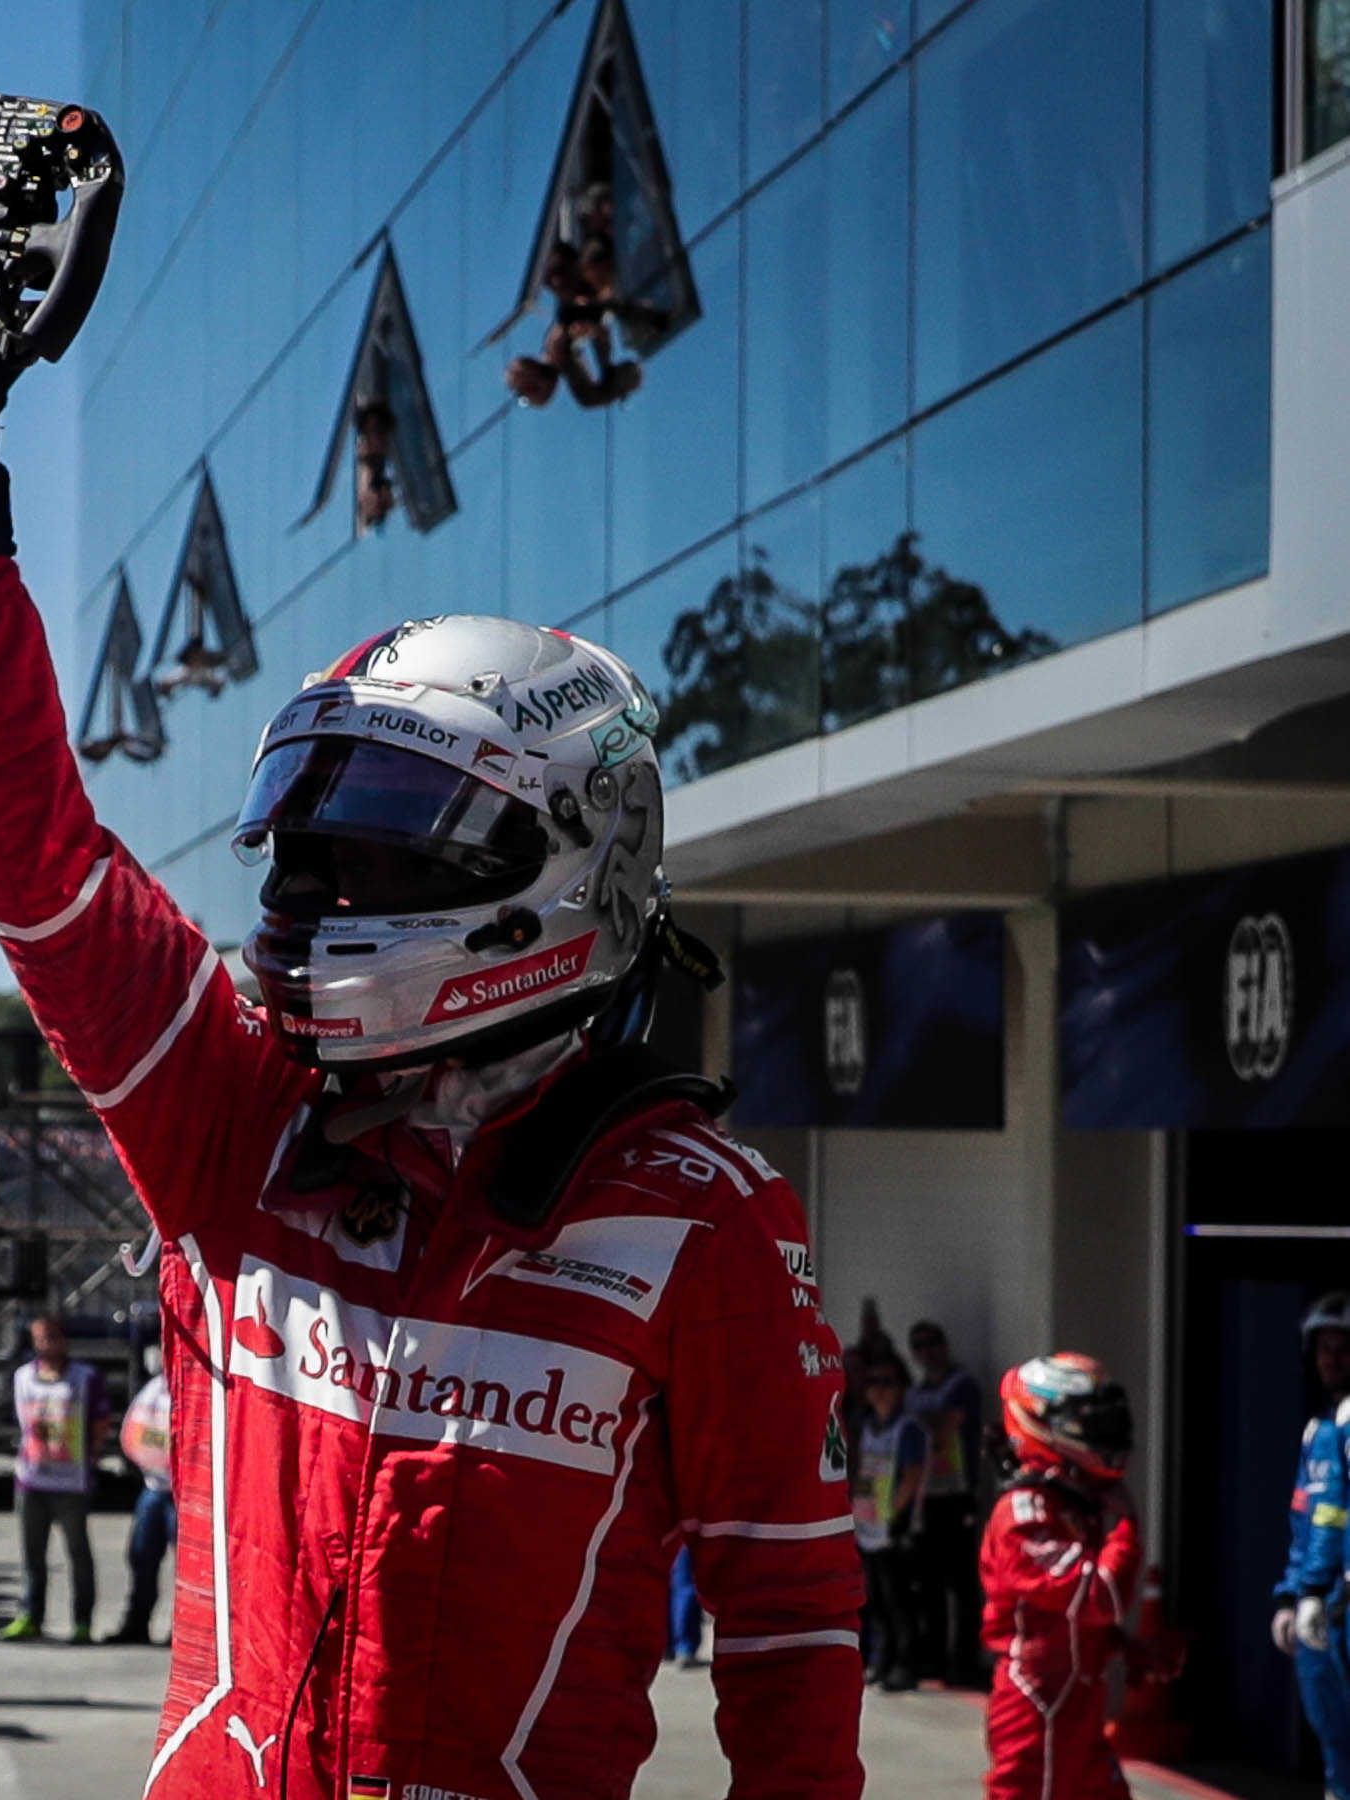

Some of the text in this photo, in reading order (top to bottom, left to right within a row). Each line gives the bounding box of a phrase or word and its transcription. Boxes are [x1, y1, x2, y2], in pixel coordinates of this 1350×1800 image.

[367, 711, 459, 749] HUBLOT
[471, 953, 578, 1004] Santander
[1229, 952, 1286, 1042] FIA
[647, 1150, 716, 1183] 70
[523, 1250, 628, 1282] SCUDERIA
[555, 1268, 644, 1302] FERRARI
[299, 1316, 618, 1449] Santander
